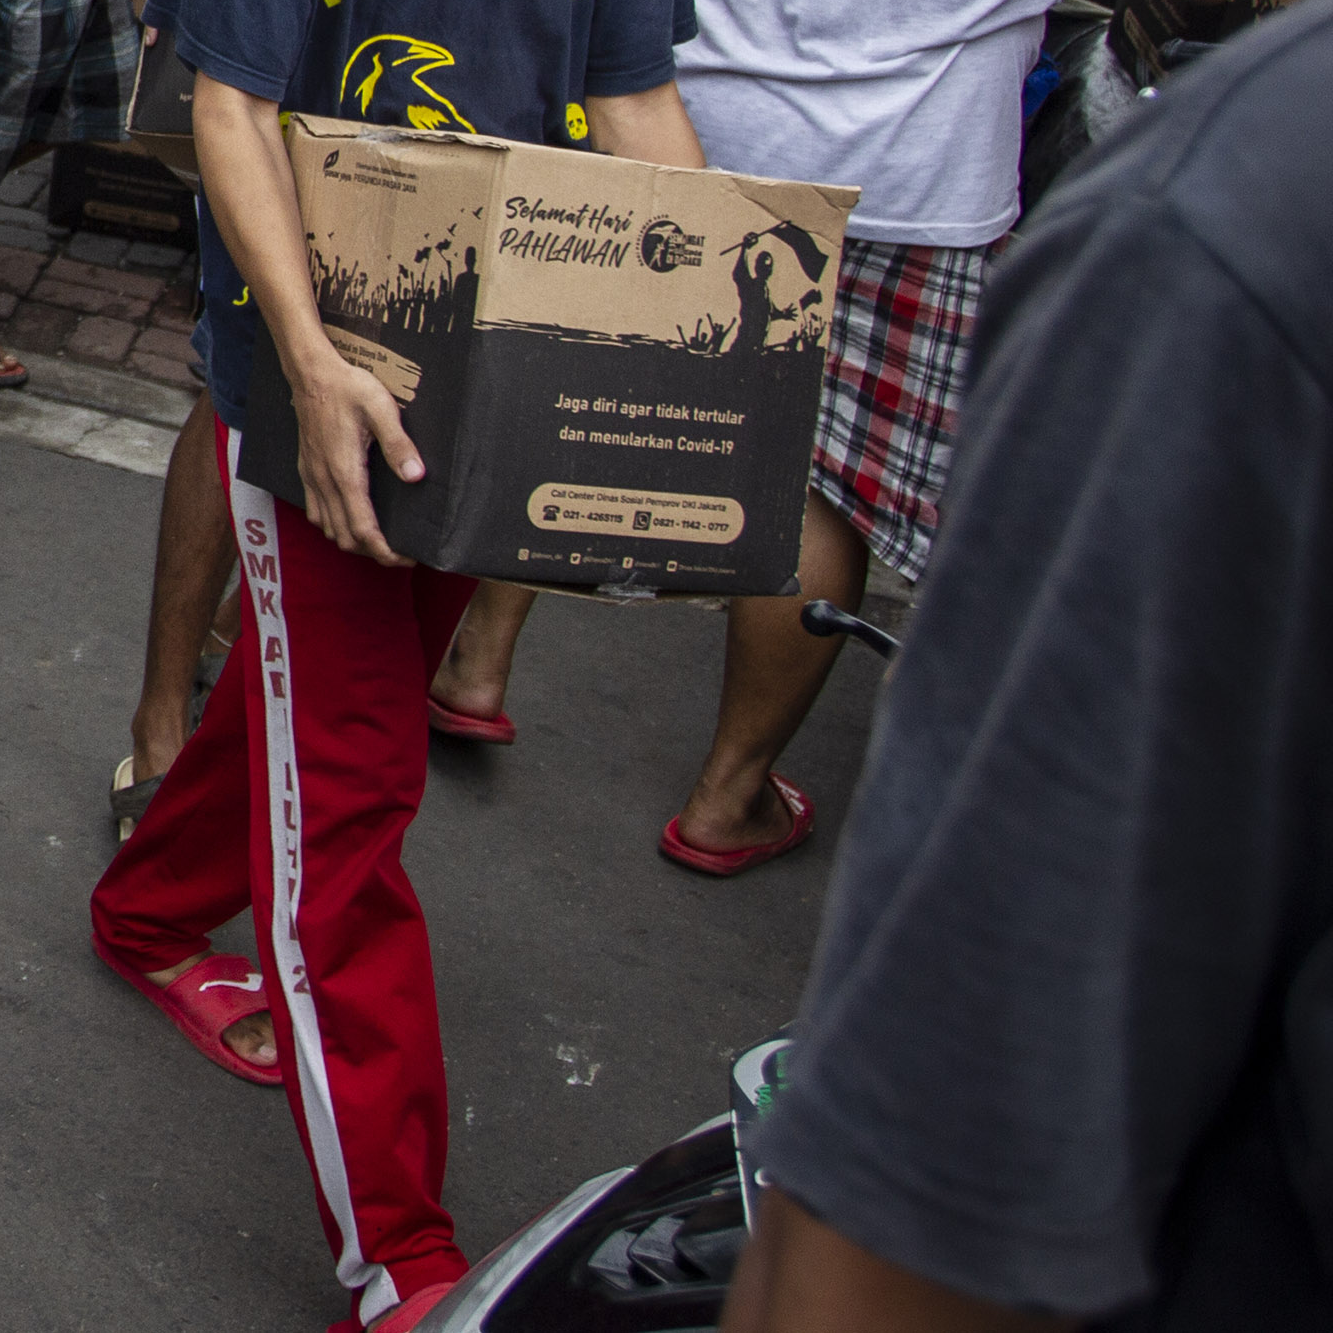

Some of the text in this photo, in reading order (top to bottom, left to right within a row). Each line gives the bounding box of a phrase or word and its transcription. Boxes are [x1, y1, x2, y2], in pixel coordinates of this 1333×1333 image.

[505, 196, 634, 234] Selamat Hari
[498, 227, 631, 268] PAHLAWAN
[555, 393, 745, 425] Jaga diri agar tidak tertular
[559, 426, 734, 455] dan menularkan Covid-19
[551, 489, 727, 512] Call Center Dinas Sosial Pemprov DKI Jakarta
[243, 518, 279, 621] SMK
